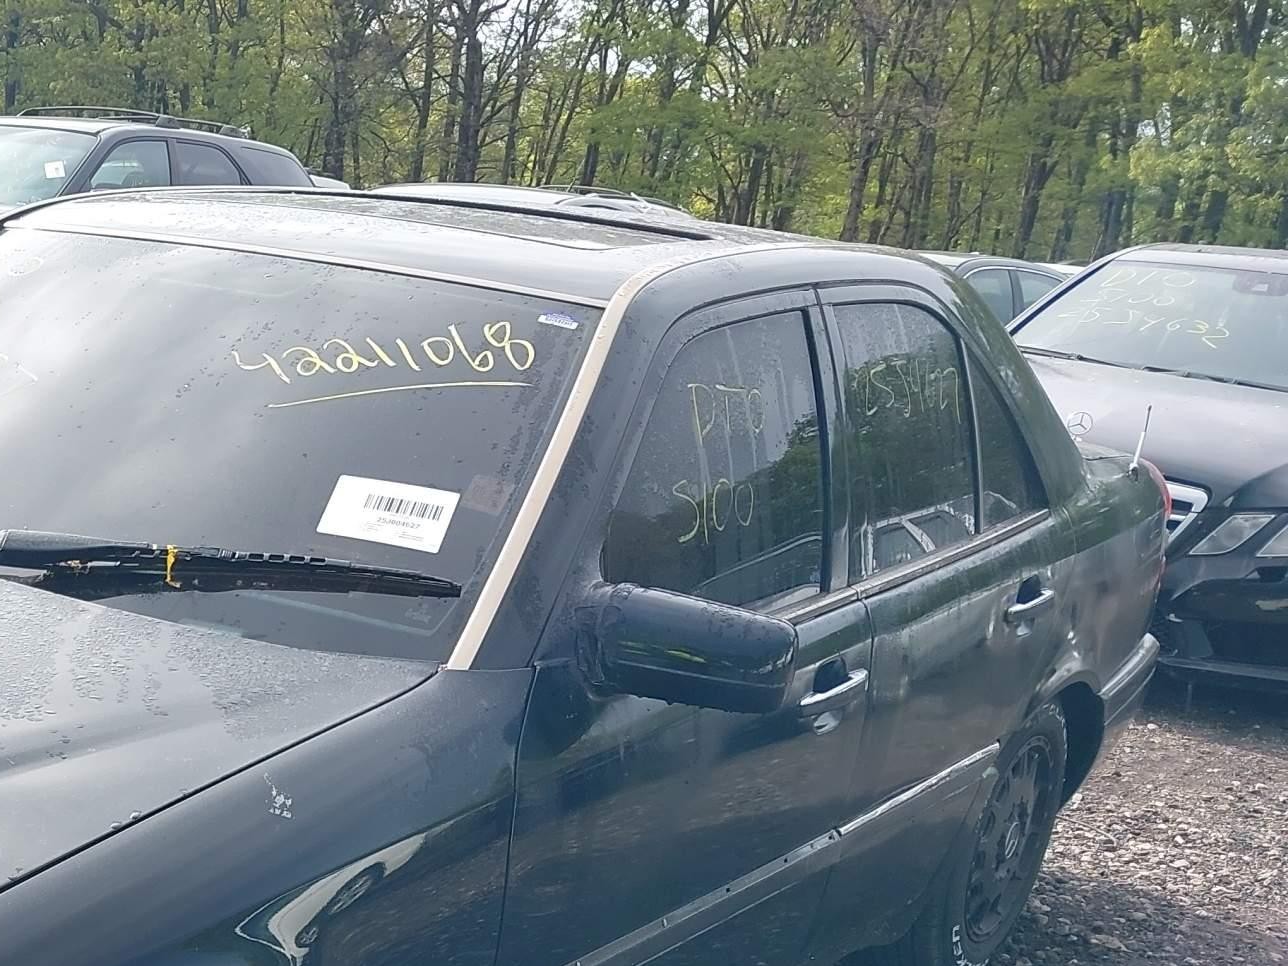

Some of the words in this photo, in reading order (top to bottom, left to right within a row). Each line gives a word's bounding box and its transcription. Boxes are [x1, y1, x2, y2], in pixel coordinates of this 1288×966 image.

[231, 321, 536, 384] 42211068
[688, 383, 765, 446] DTO
[672, 479, 754, 545] S100
